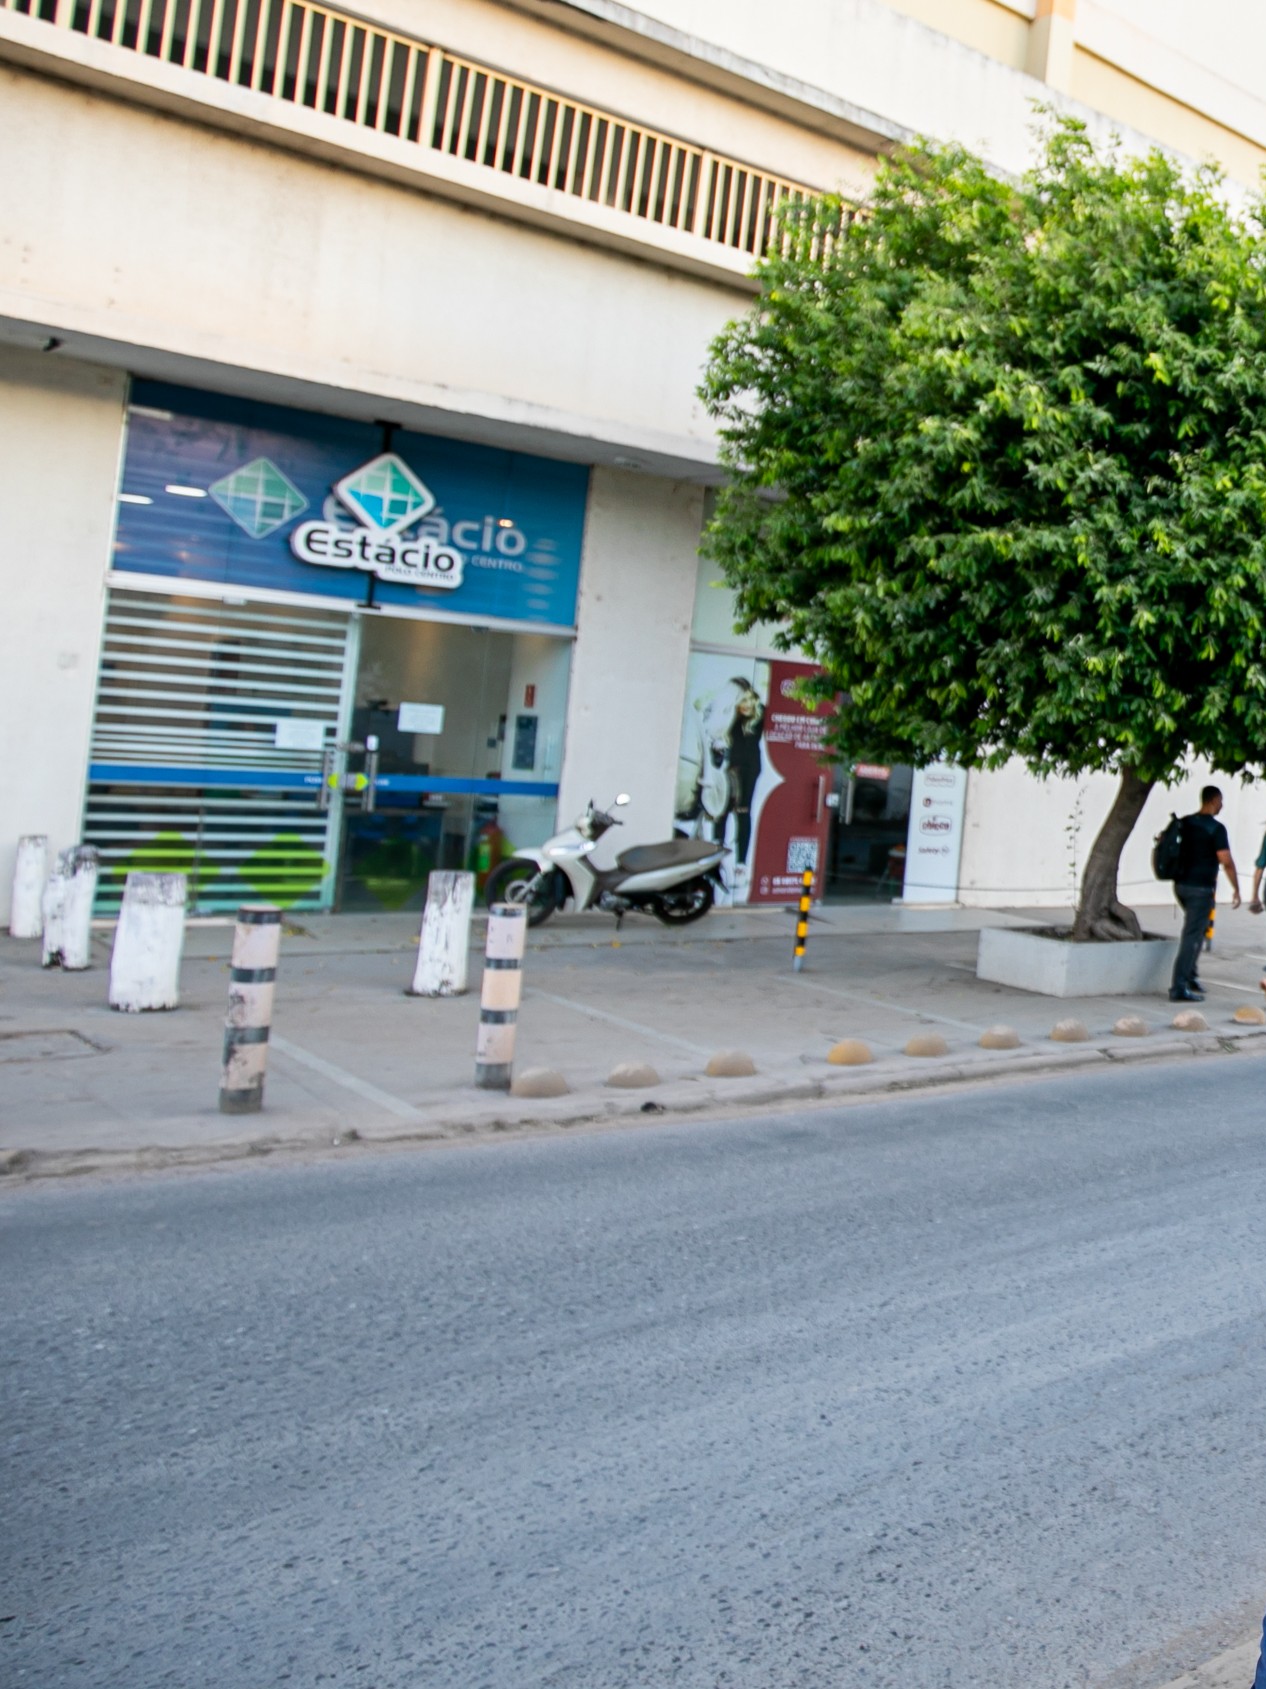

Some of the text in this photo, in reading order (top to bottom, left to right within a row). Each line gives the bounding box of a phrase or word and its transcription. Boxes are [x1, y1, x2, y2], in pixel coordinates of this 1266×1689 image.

[306, 528, 455, 572] Estácio
[471, 554, 523, 572] CENTRO
[415, 570, 454, 581] CENTRO
